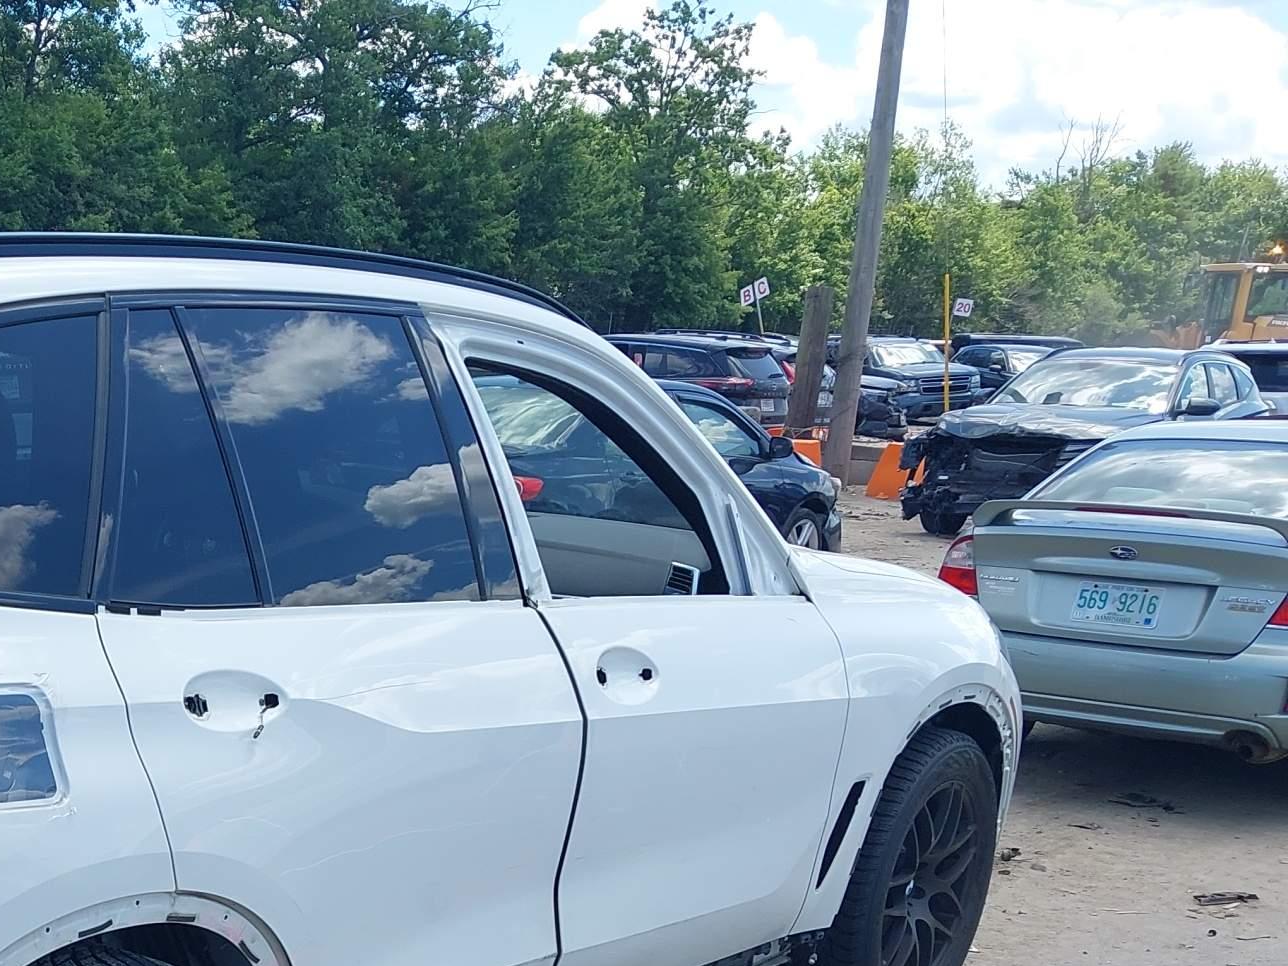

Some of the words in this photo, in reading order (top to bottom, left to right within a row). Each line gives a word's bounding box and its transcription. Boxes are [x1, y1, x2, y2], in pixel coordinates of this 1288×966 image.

[757, 281, 767, 295] C
[743, 289, 752, 304] B
[956, 302, 971, 313] 20
[1076, 589, 1109, 610] 569
[1116, 592, 1159, 615] 9216
